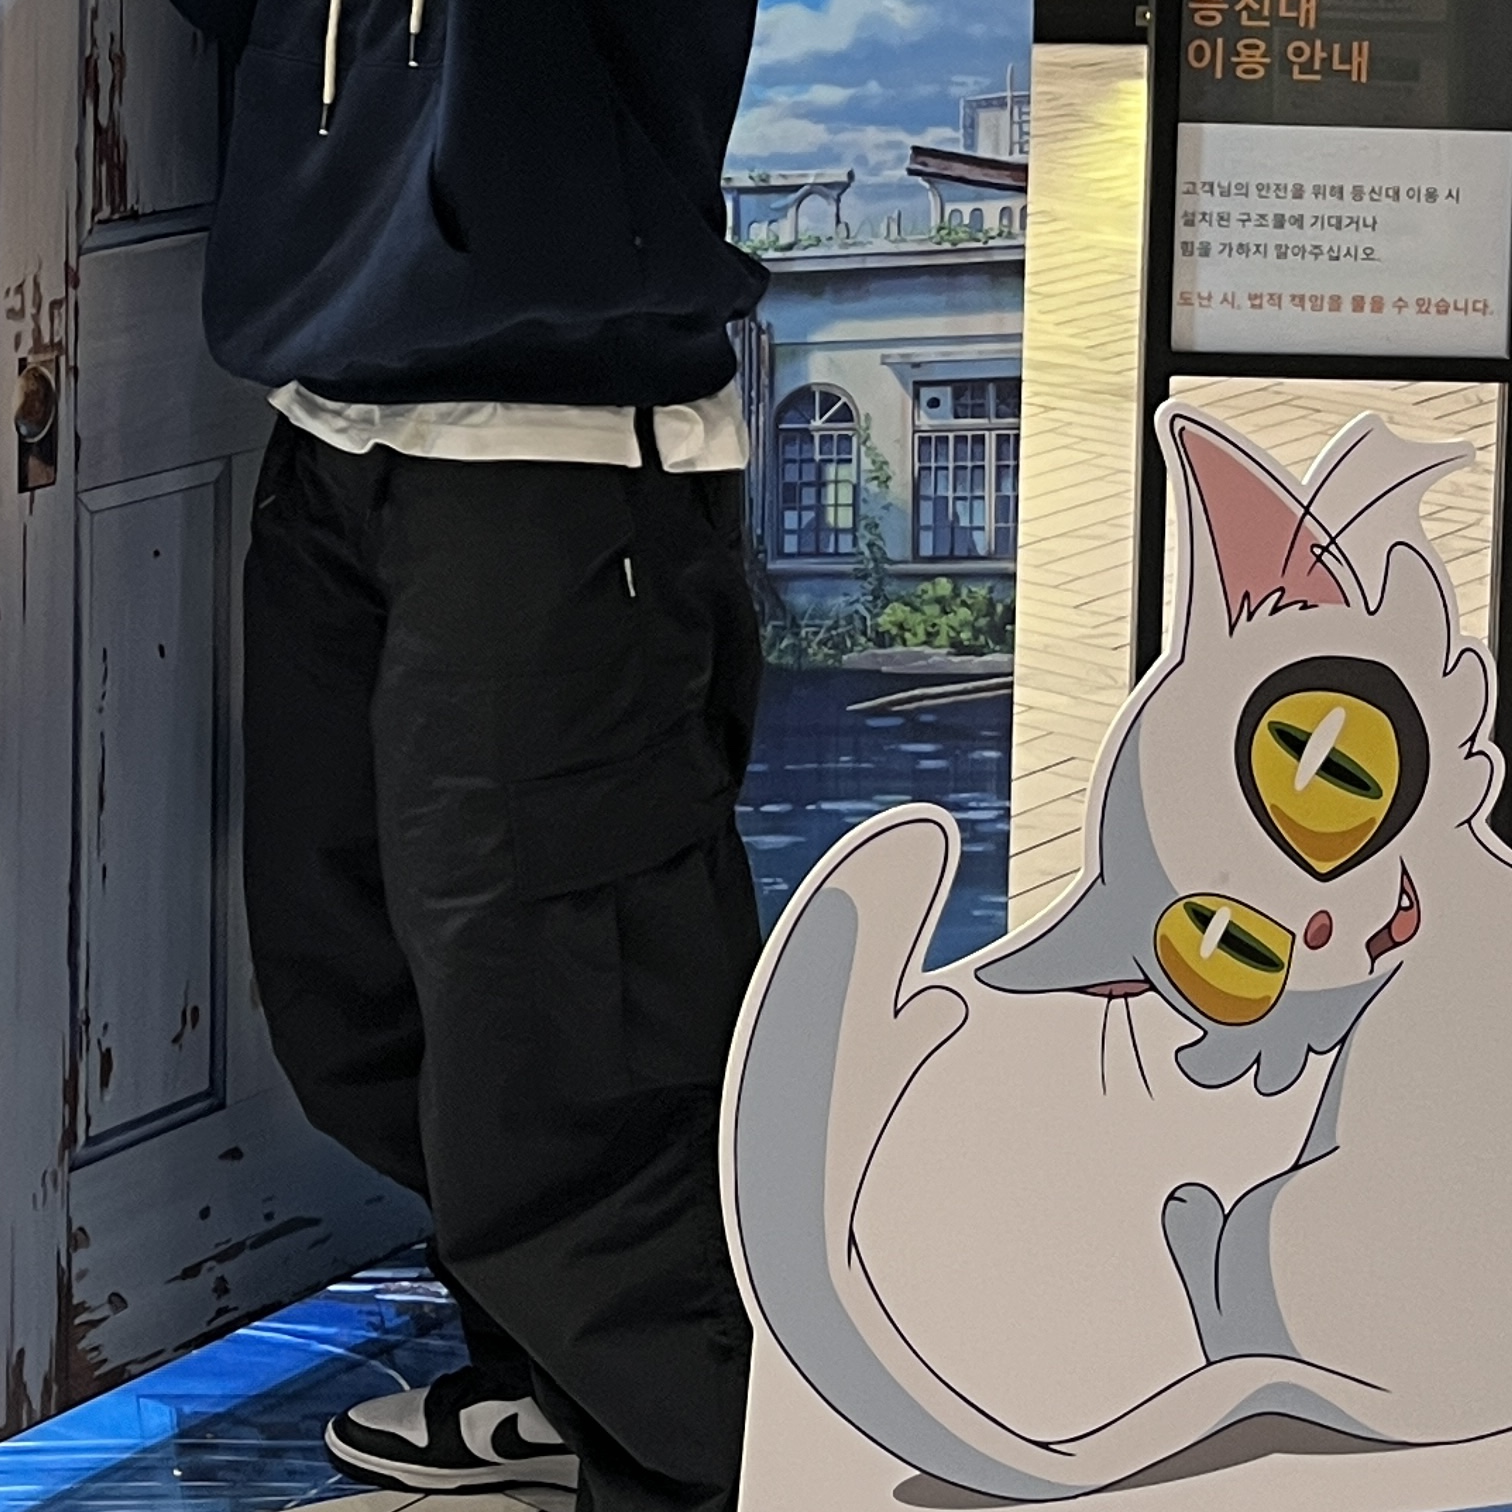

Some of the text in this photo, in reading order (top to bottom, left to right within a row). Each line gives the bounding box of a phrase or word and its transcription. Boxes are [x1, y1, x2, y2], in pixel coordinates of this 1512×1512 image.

[1187, 37, 1369, 83] 이용 안내
[1182, 181, 1460, 204] 고객님의 안전을 위해 등신대 이용 시
[1181, 210, 1378, 232] 설치된 구조물에 기대거나
[1180, 241, 1211, 258] 힘을
[1218, 242, 1268, 259] 가하지
[1177, 291, 1213, 308] 도난
[1248, 292, 1282, 310] 법적
[1289, 294, 1342, 313] 책임을
[1351, 295, 1384, 314] 물을
[1392, 297, 1409, 315] 수
[1416, 298, 1494, 317] 있습니다.
